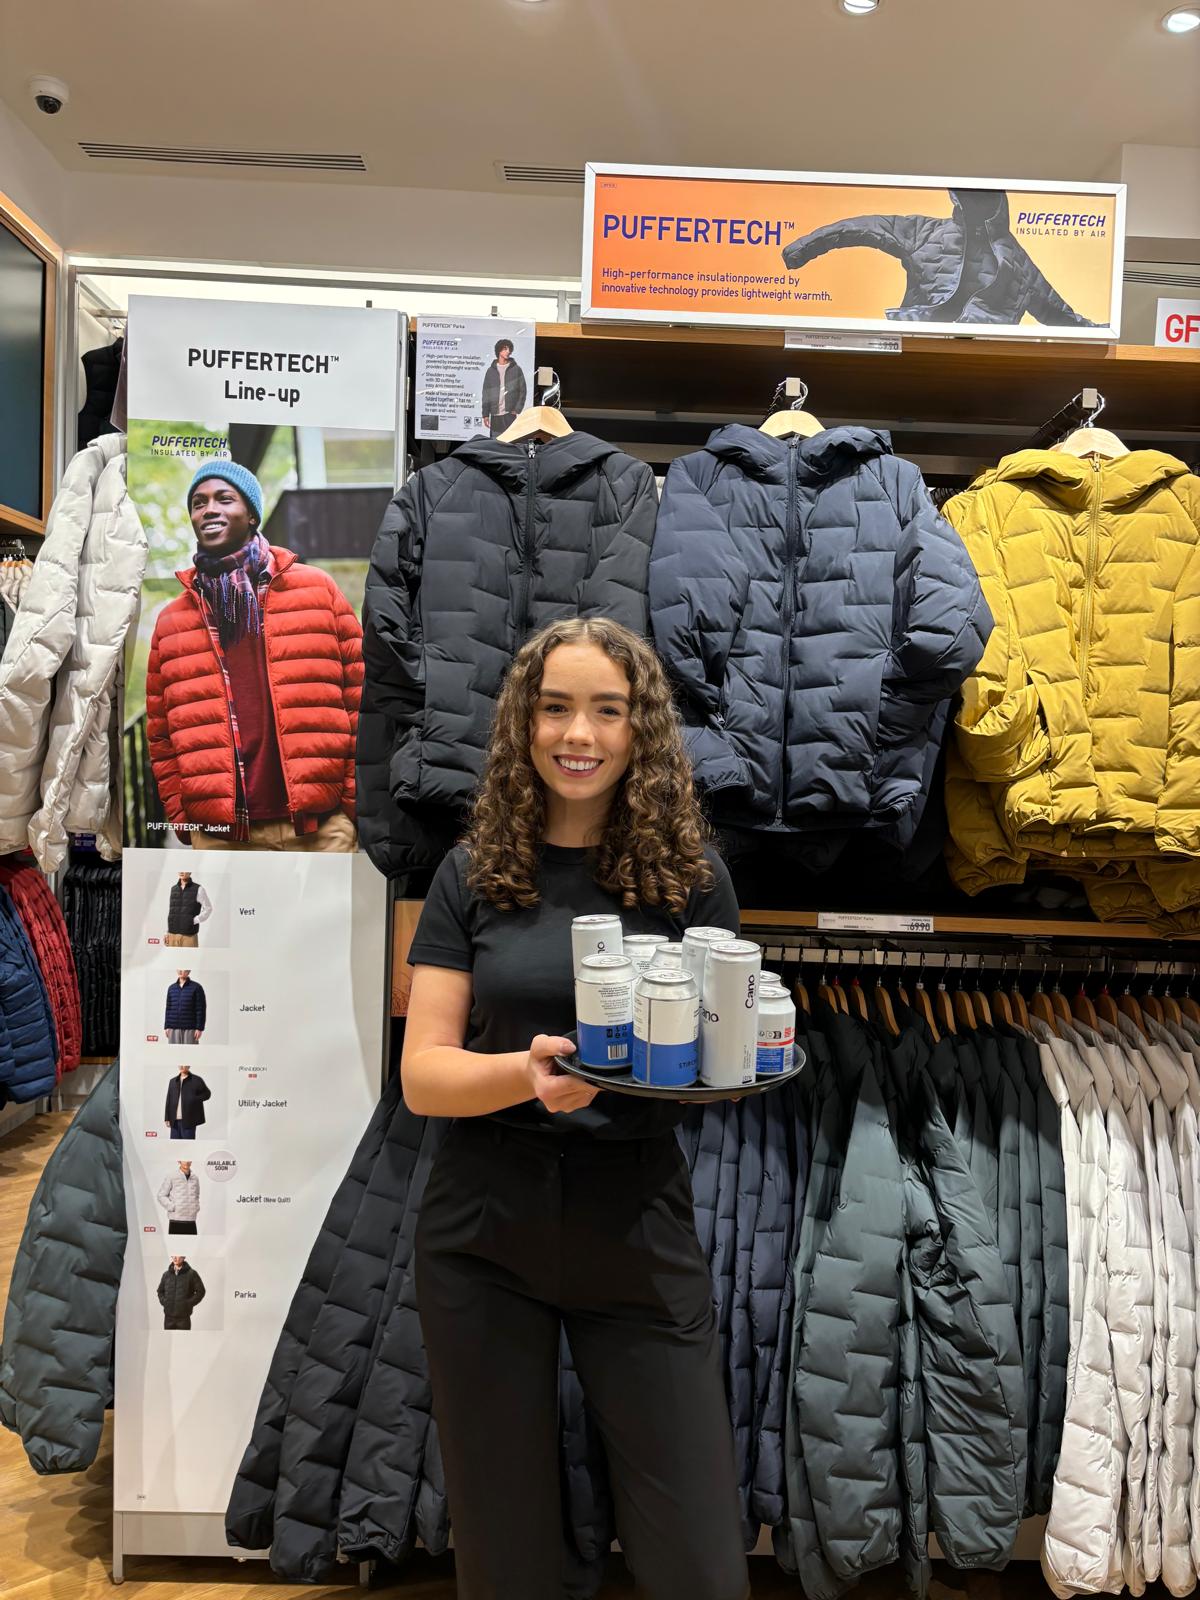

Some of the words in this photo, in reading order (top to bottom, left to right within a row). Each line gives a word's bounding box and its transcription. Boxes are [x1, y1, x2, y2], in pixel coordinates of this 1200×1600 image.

[1017, 212, 1106, 227] PUFFERTECH
[1016, 227, 1069, 236] INSULATED
[602, 268, 694, 283] High-performance
[697, 271, 786, 288] insulationpowered
[788, 274, 800, 287] by
[601, 283, 647, 294] innovative
[649, 285, 699, 298] technology
[701, 287, 739, 299] provides
[741, 288, 792, 300] lightweight
[793, 289, 833, 302] warmth.
[224, 380, 301, 408] Line-up
[151, 435, 228, 449] PUFFERTECH
[150, 449, 197, 458] INSULATED
[200, 449, 211, 458] BY
[213, 449, 228, 458] AIR
[204, 823, 231, 834] Jacket
[239, 907, 255, 916] Vest
[744, 974, 755, 1009] Cano
[239, 1004, 266, 1012] Jacket
[238, 1099, 260, 1108] Utility
[262, 1099, 288, 1108] Jacket
[236, 1194, 262, 1204] Jacket
[234, 1290, 257, 1300] Parka
